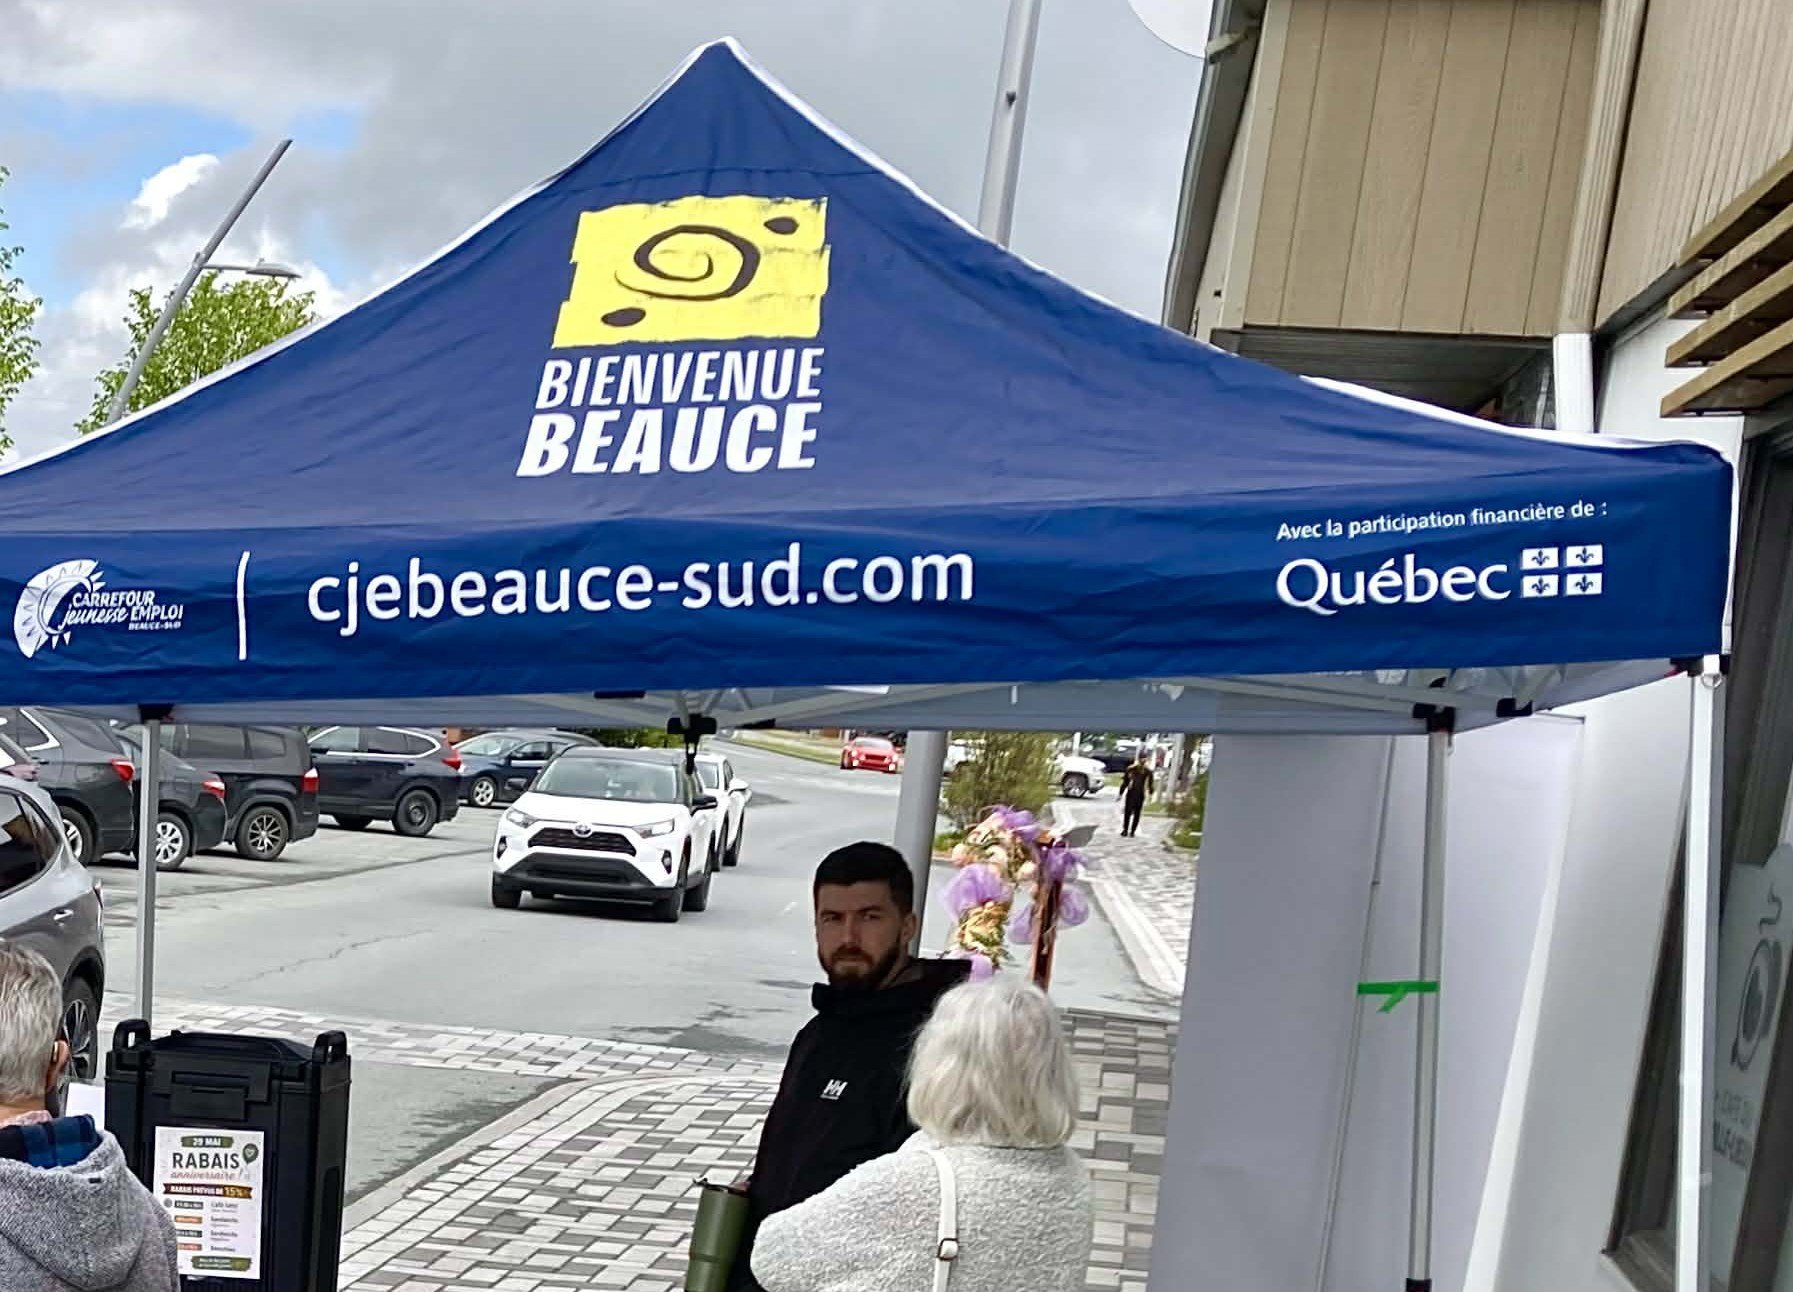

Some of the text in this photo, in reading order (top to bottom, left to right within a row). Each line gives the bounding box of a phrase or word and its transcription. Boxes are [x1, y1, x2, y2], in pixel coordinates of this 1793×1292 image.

[535, 348, 824, 409] BIENVENUE
[516, 402, 822, 477] BEAUCE
[1276, 522, 1322, 541] Avec
[1326, 518, 1343, 536] la
[1348, 511, 1465, 539] participation
[1470, 502, 1565, 526] financière
[1571, 499, 1595, 518] de
[72, 590, 155, 608] CARREFOUR
[308, 542, 973, 636] cjebeauce-sud.com
[1276, 553, 1511, 616] Québec
[58, 604, 184, 629] jeunesse EMPLOI
[172, 1152, 240, 1169] RABAIS
